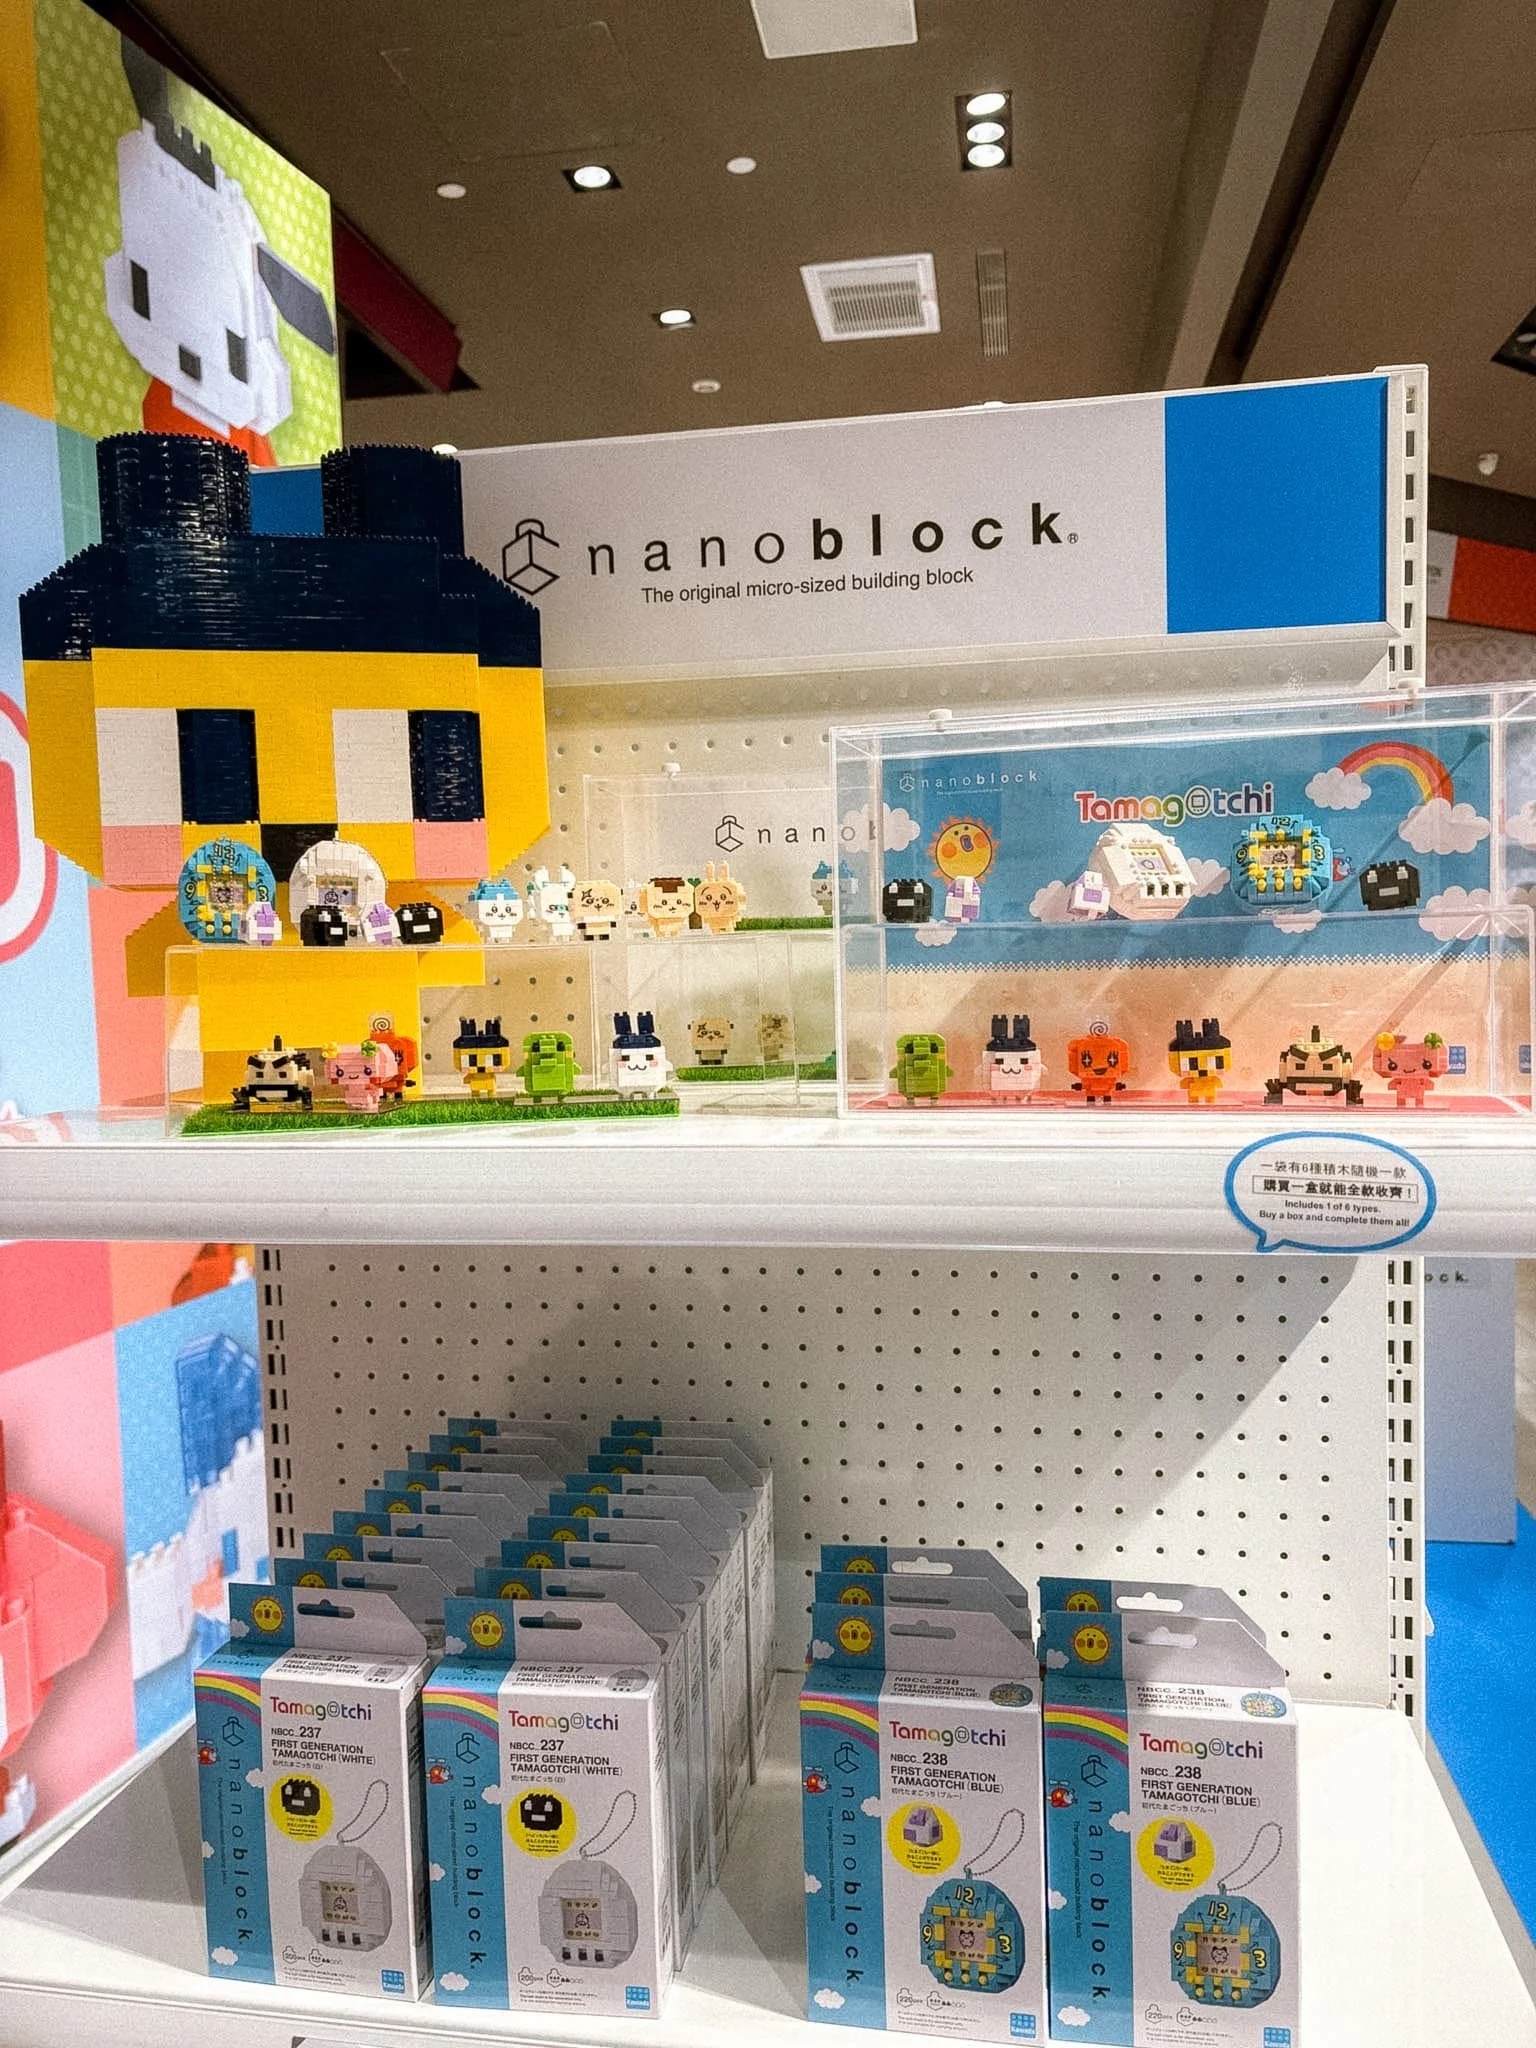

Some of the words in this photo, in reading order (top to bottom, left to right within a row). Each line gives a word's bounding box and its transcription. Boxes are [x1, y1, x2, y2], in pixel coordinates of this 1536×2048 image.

[641, 586, 674, 603] The
[678, 581, 741, 604] original
[746, 575, 846, 598] micro-sized
[851, 570, 920, 592] building
[926, 566, 973, 585] block
[921, 770, 1037, 789] nanoblock
[1075, 782, 1273, 825] Tamagotchi
[1285, 1200, 1324, 1210] Includes
[1333, 1203, 1343, 1211] of
[1344, 1203, 1350, 1211] 6
[1352, 1204, 1381, 1214] types.
[1259, 1210, 1276, 1220] Buy
[1287, 1212, 1303, 1220] box
[1306, 1213, 1323, 1222] and
[1325, 1214, 1368, 1225] complete
[1370, 1216, 1393, 1226] them
[270, 1696, 372, 1721] Tamagotchi
[508, 1710, 619, 1733] Tamagotchi
[889, 1720, 1006, 1746] Tamagotchi
[271, 1739, 298, 1749] FIRST
[301, 1741, 364, 1754] GENERATION
[1139, 1733, 1263, 1759] Tamagotchi
[273, 1749, 337, 1763] TAMAGOTCHI
[338, 1754, 376, 1766] (WHITE)
[510, 1754, 539, 1763] FIRST
[541, 1755, 610, 1766] GENERATION
[511, 1763, 581, 1775] TAMAGOTCHI
[582, 1766, 623, 1777] (WHITE)
[890, 1765, 921, 1776] FIRST
[924, 1768, 996, 1782] GENERATION
[891, 1776, 965, 1791] TAMAGOTCHI
[967, 1782, 1004, 1794] (BLUE)
[1141, 1779, 1174, 1790] FIRST
[1176, 1781, 1253, 1796] GENERATION
[1142, 1790, 1219, 1805] TAMAGOTCHI
[1222, 1794, 1261, 1808] (BLUE)
[228, 1759, 253, 1941] nanoblock
[463, 1775, 487, 1964] nanoblock
[841, 1786, 864, 1982] nanoblock
[1088, 1800, 1111, 1998] nanoblock
